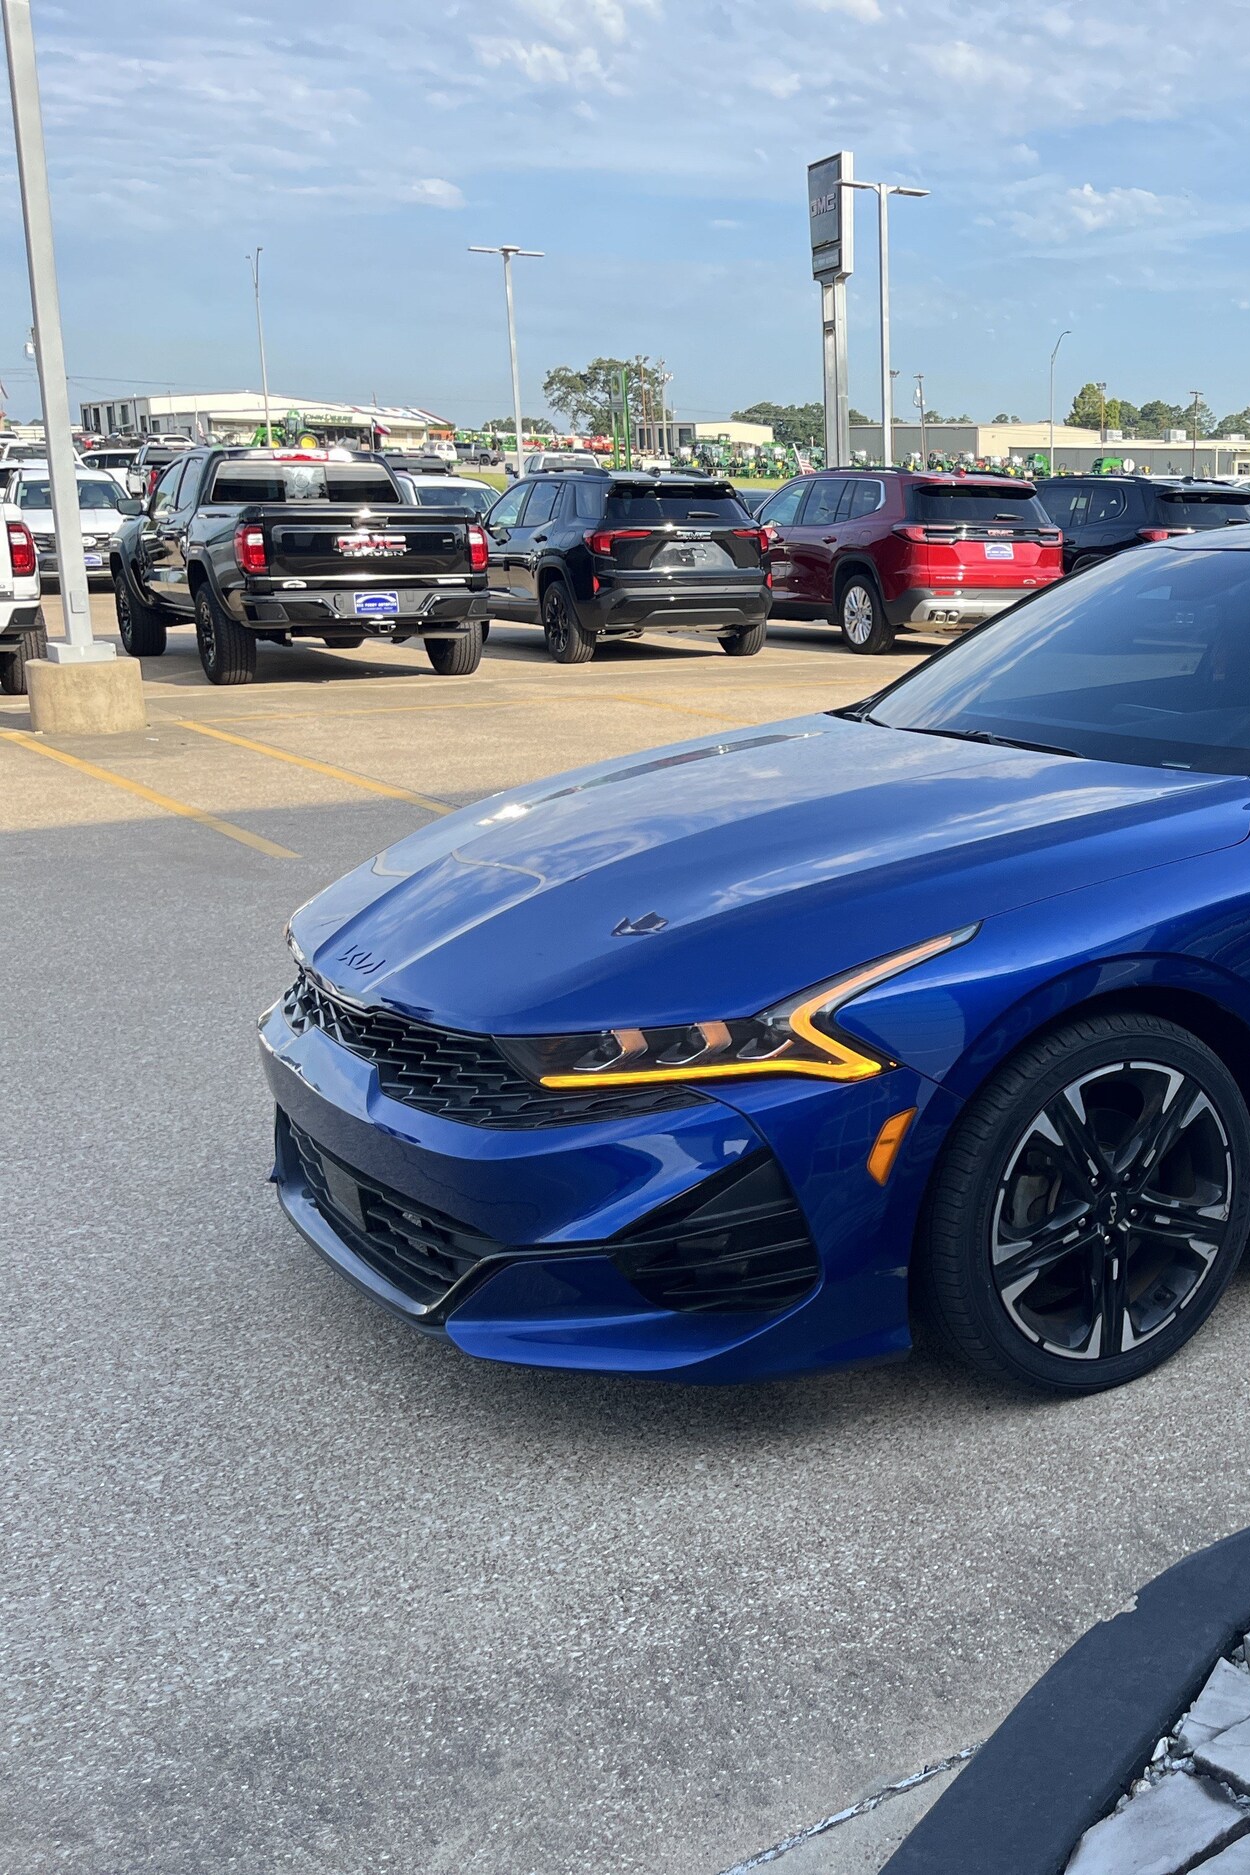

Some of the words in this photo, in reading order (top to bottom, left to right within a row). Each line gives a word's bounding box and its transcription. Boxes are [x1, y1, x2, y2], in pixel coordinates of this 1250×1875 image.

[810, 193, 836, 218] GMC
[676, 531, 713, 539] GMC
[987, 529, 1014, 537] GMC
[337, 535, 406, 550] GMC
